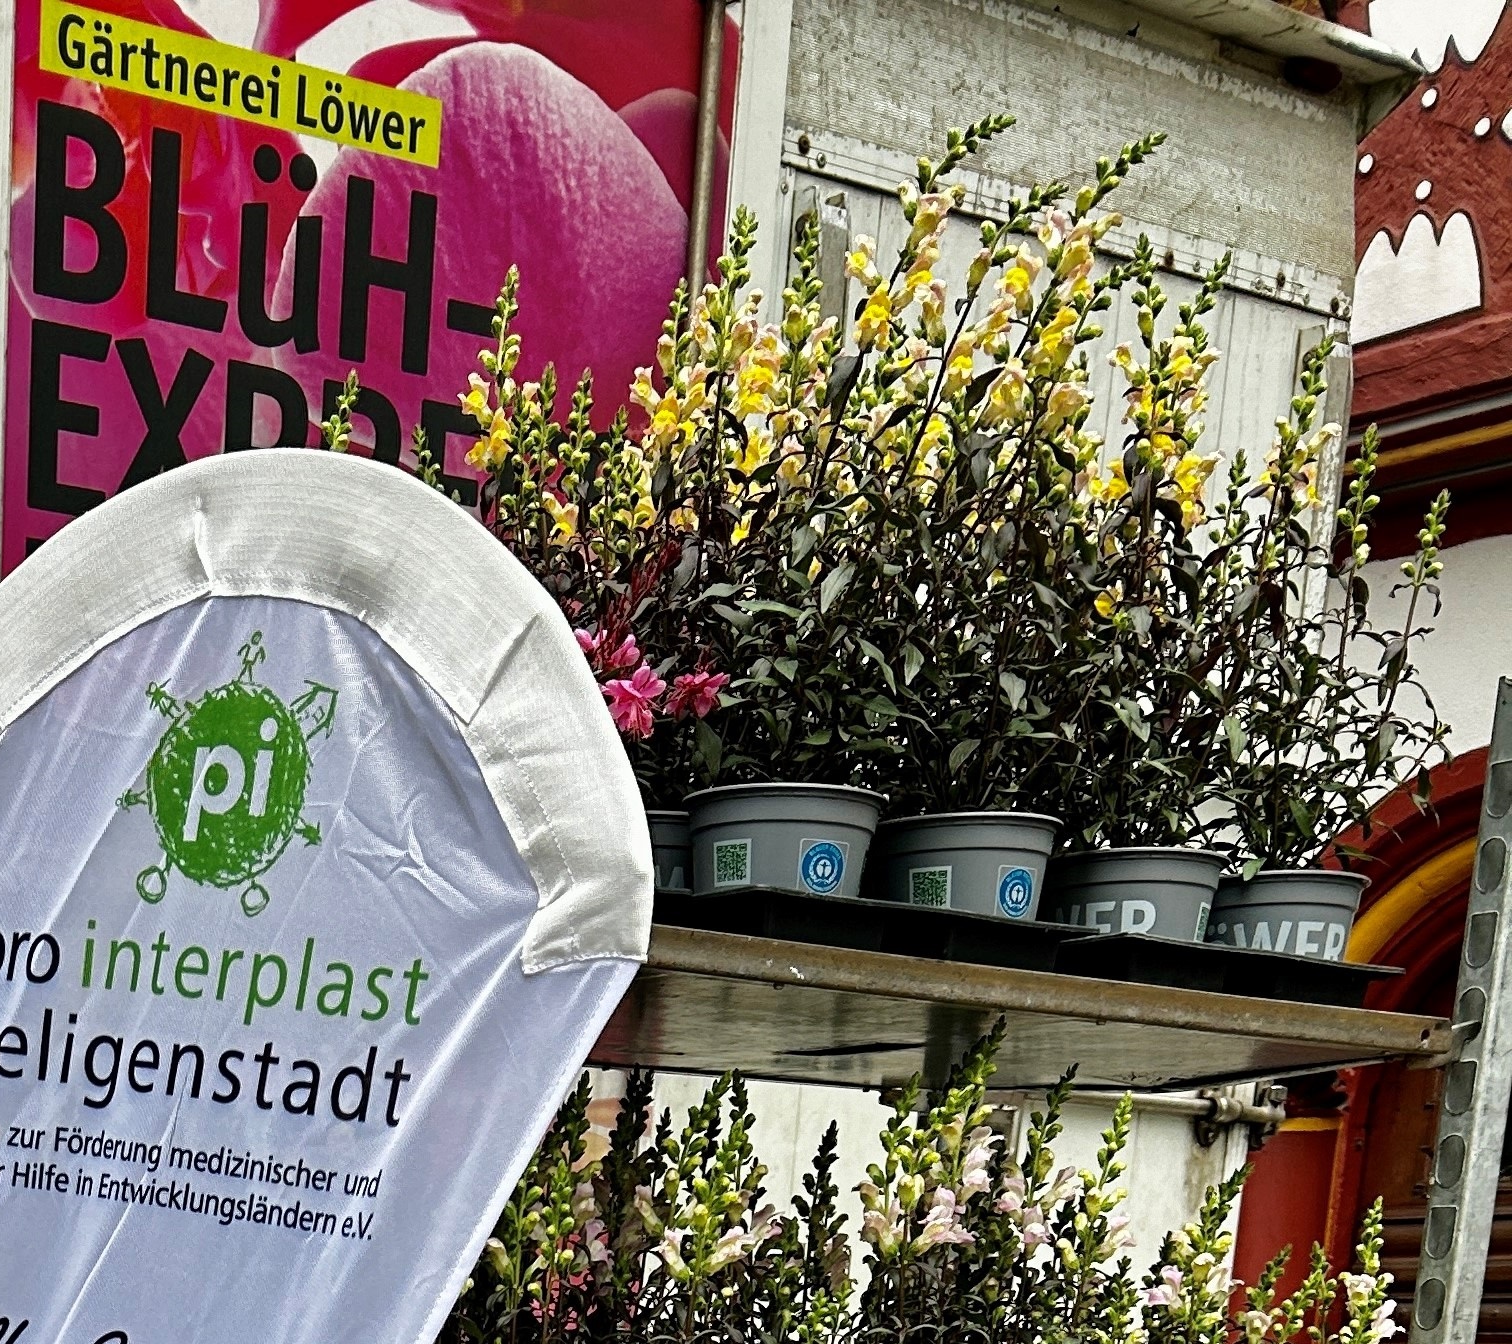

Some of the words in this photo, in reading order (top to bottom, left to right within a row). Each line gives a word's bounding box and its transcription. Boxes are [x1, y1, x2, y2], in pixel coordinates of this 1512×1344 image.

[57, 14, 281, 119] Gärtnerei
[297, 72, 426, 154] Löwer
[182, 718, 276, 841] pi
[82, 919, 430, 1026] interplast
[7, 1126, 45, 1151] zur
[53, 1125, 163, 1171] Förderung
[169, 1142, 336, 1196] medizinischer
[343, 1168, 382, 1199] und
[11, 1161, 69, 1195] Hilfe
[76, 1171, 94, 1197] in
[97, 1173, 337, 1237] Entwicklungsländern
[340, 1211, 374, 1242] e.V.
